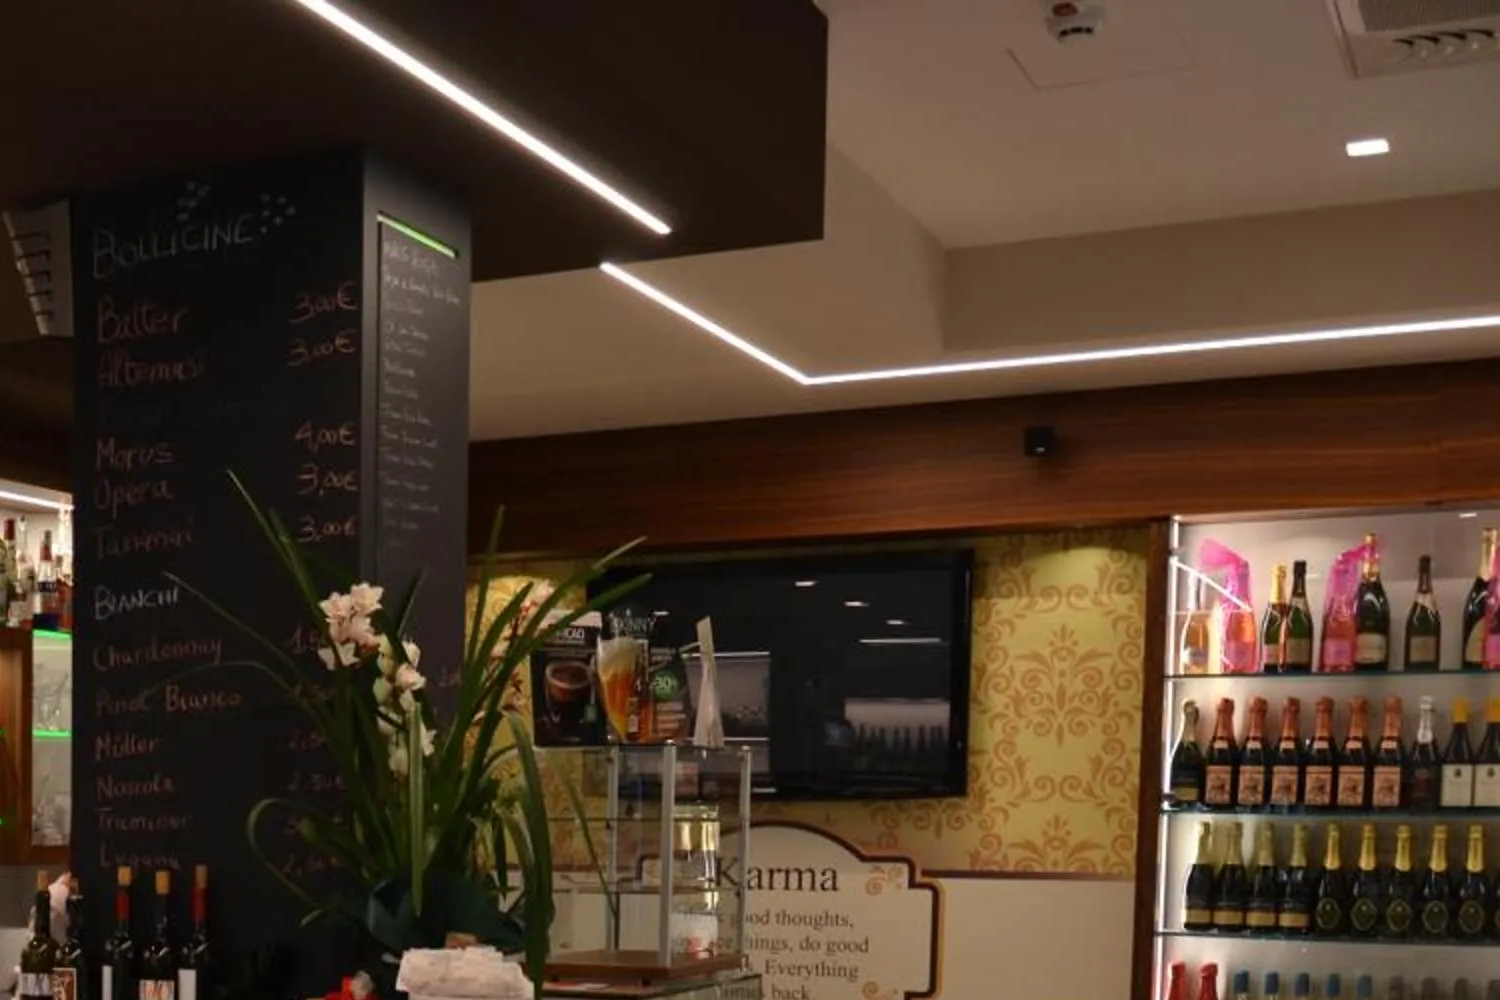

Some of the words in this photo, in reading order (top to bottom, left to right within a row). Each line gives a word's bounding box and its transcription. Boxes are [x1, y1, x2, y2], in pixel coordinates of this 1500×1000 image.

[92, 213, 255, 281] BOLLICINE
[93, 478, 175, 521] Opera
[714, 856, 839, 892] Karma
[775, 908, 854, 930] thoughts,
[798, 936, 821, 953] do
[825, 936, 870, 955] good
[764, 959, 860, 982] Everything
